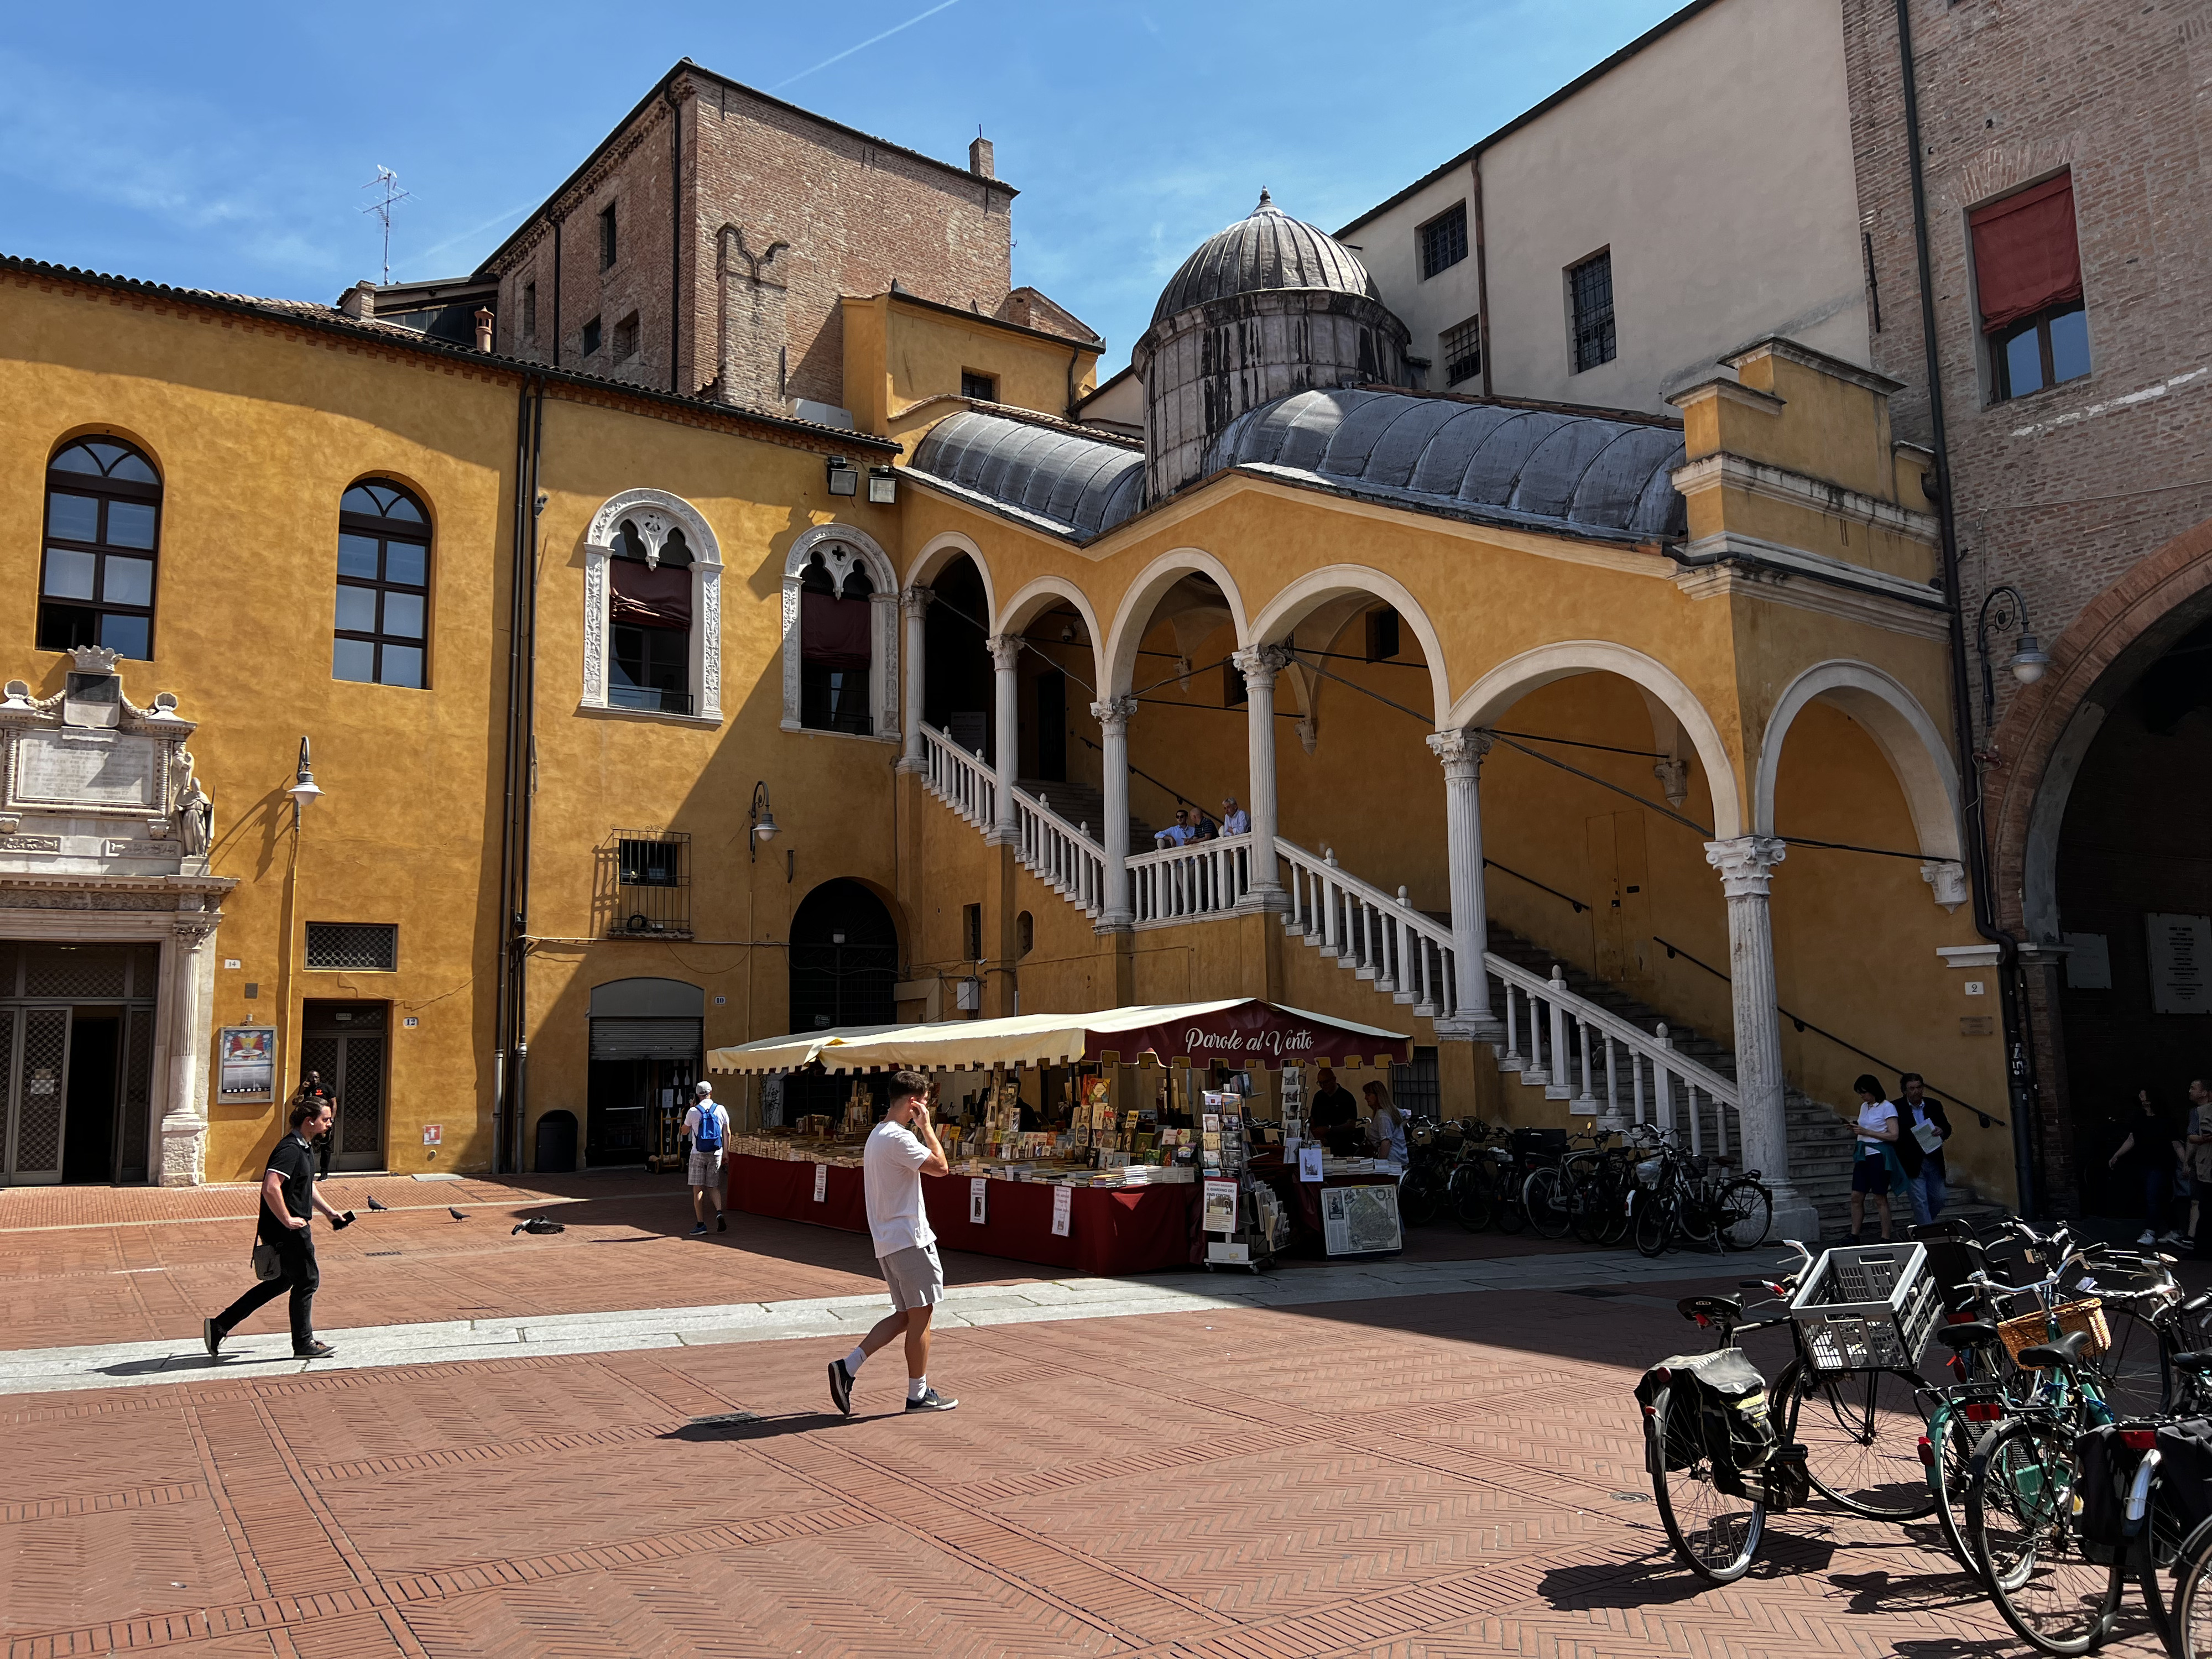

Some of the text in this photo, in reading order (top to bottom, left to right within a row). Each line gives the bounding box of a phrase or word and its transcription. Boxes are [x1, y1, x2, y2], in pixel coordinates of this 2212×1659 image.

[1971, 984, 1978, 993] 2
[1185, 1027, 1314, 1056] Parole al Vento
